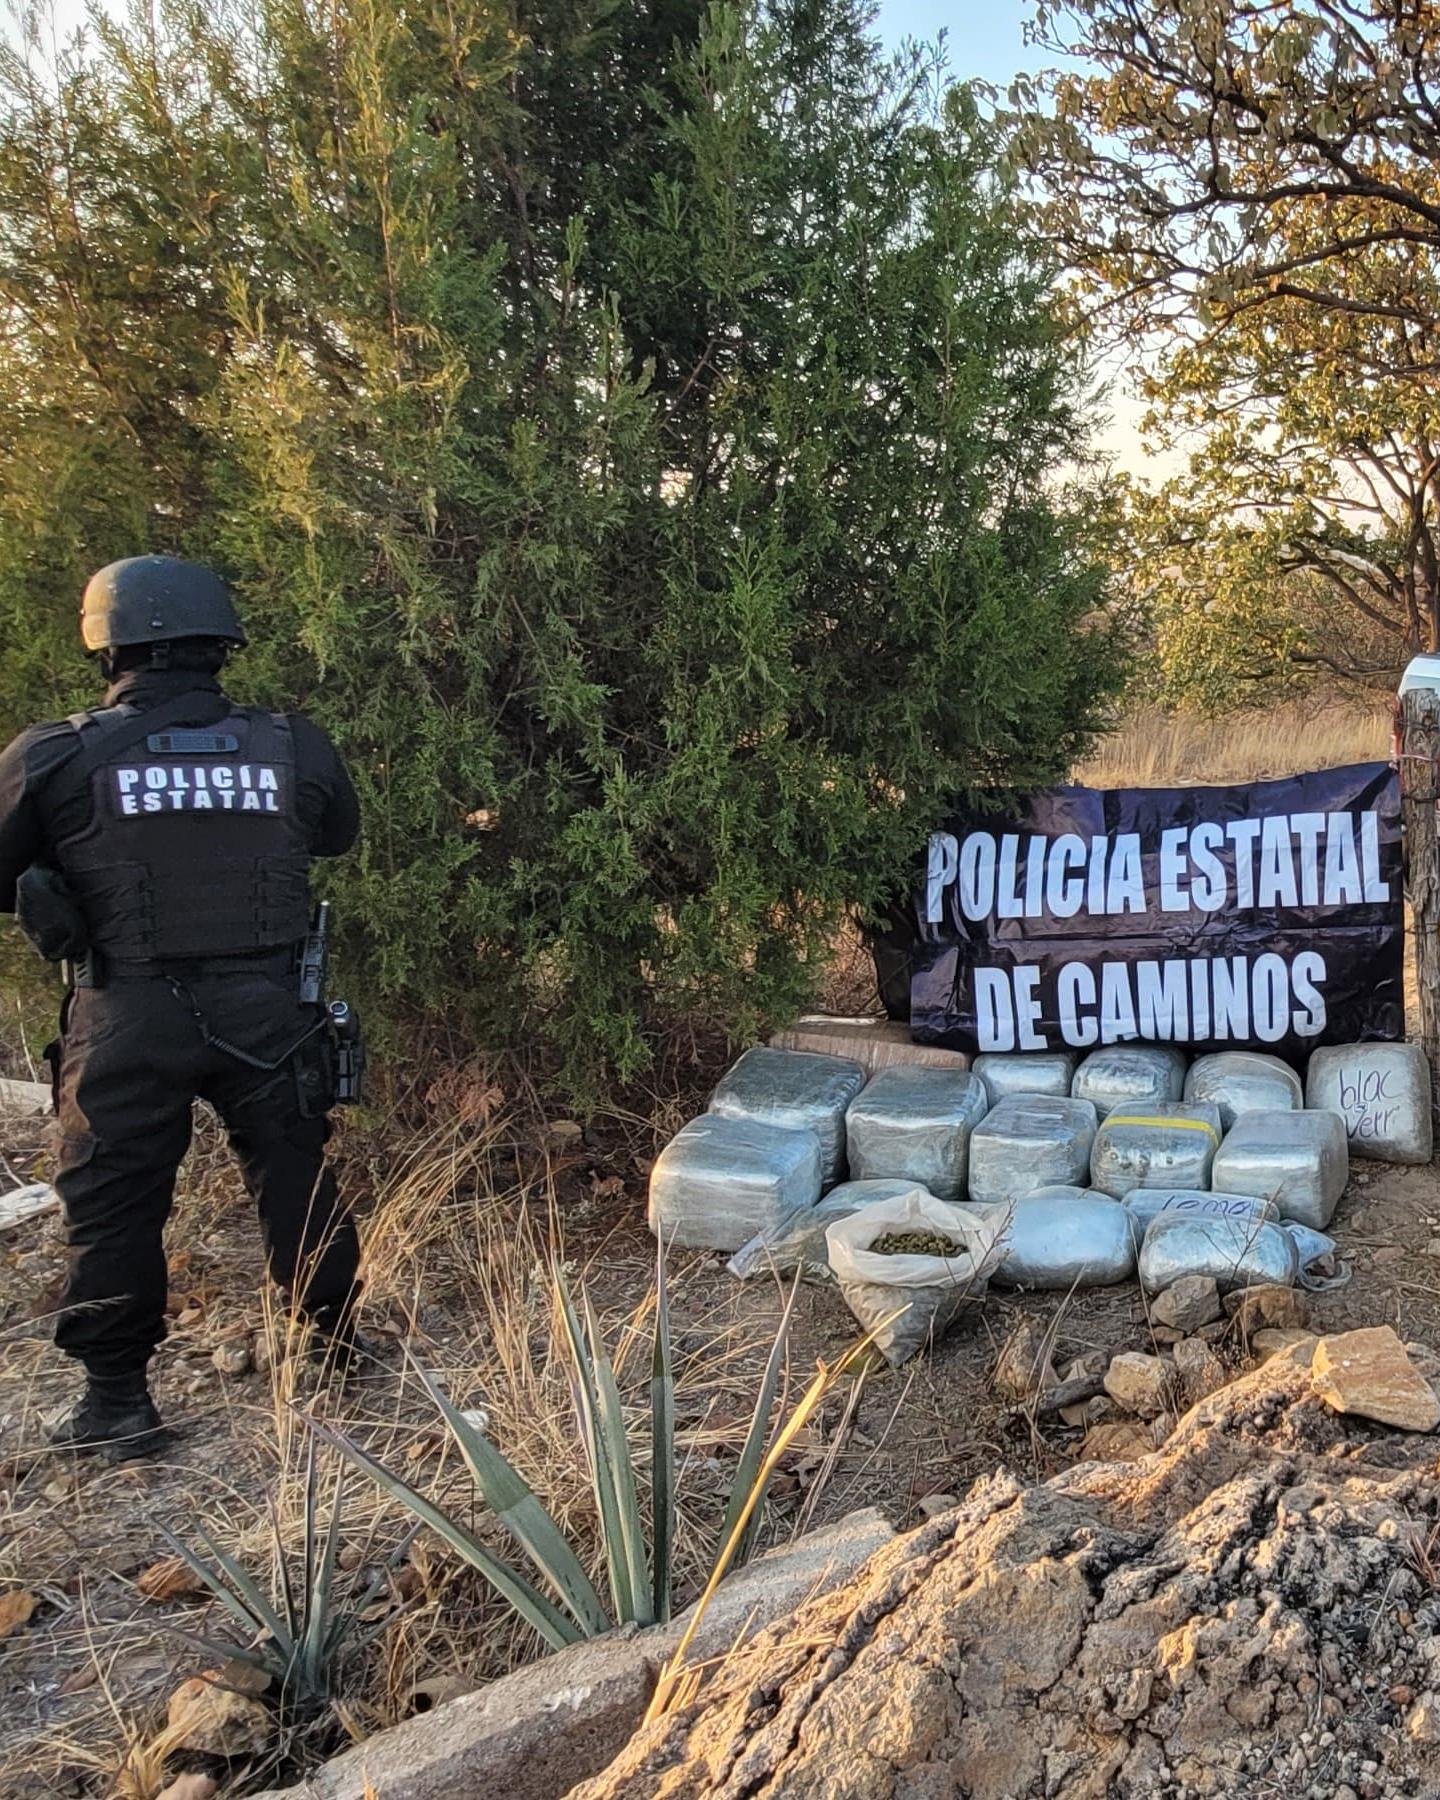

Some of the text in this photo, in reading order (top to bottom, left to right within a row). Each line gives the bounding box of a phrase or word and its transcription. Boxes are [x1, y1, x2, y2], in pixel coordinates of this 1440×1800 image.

[121, 790, 279, 815] ESTATAL
[926, 810, 1390, 923] POLICIA ESTATAL
[973, 952, 1327, 1052] DE CAMINOS
